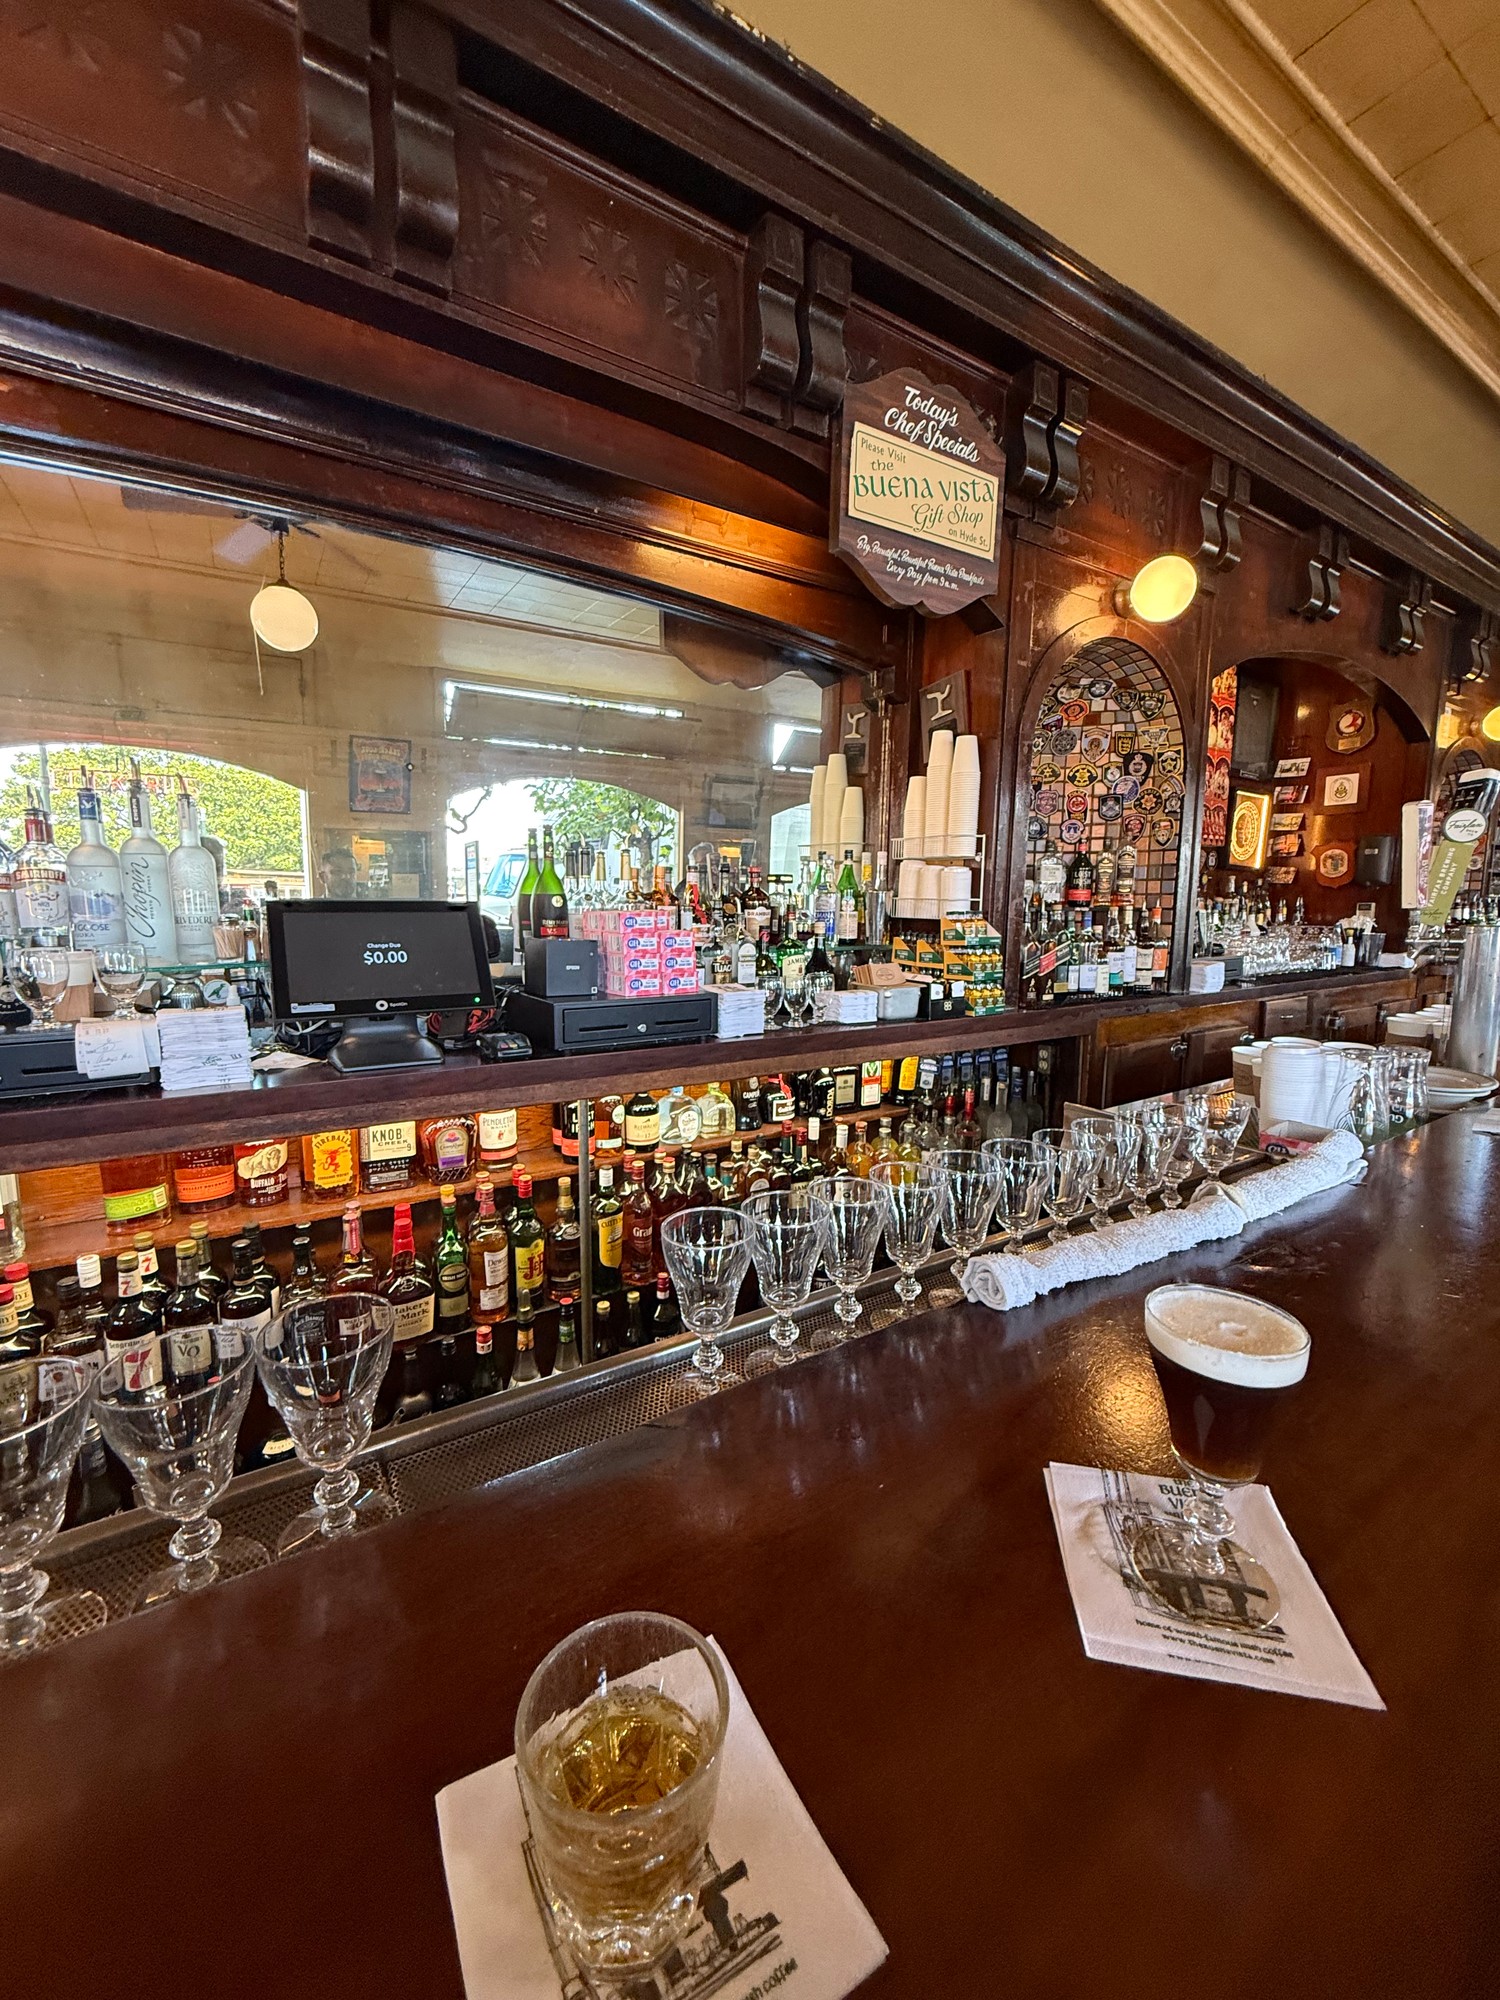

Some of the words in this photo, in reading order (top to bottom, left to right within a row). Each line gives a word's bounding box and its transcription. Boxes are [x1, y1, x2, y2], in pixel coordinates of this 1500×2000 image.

[904, 385, 960, 428] Today's
[884, 408, 924, 443] Chef
[922, 424, 980, 462] Specials
[860, 437, 885, 456] Please
[887, 447, 906, 464] Visit
[870, 459, 894, 472] the
[853, 474, 934, 499] BUENA
[938, 480, 994, 502] VISTA
[912, 503, 944, 533] Gift
[947, 502, 984, 528] Shop
[948, 528, 958, 538] on
[959, 528, 977, 544] Hyde
[979, 536, 988, 547] St.
[886, 560, 906, 582] Every
[907, 566, 922, 586] Day
[921, 572, 938, 587] from
[1448, 818, 1484, 832] Fairfax
[15, 870, 65, 880] SMIRNOFF
[1428, 878, 1442, 907] FAIRFAX
[1439, 847, 1456, 878] BREWING
[1440, 862, 1458, 895] COMPANY
[127, 857, 161, 938] Chopin
[363, 951, 408, 965] $0.00
[483, 1114, 514, 1126] PENDLETON
[572, 1111, 595, 1123] LST
[314, 1135, 350, 1149] FIREBALL
[372, 1128, 402, 1142] KNOB
[250, 1177, 274, 1189] BUFFALO
[141, 1256, 152, 1272] 7
[120, 1281, 131, 1295] 7
[401, 1308, 429, 1320] Mark
[124, 1348, 152, 1389] 7
